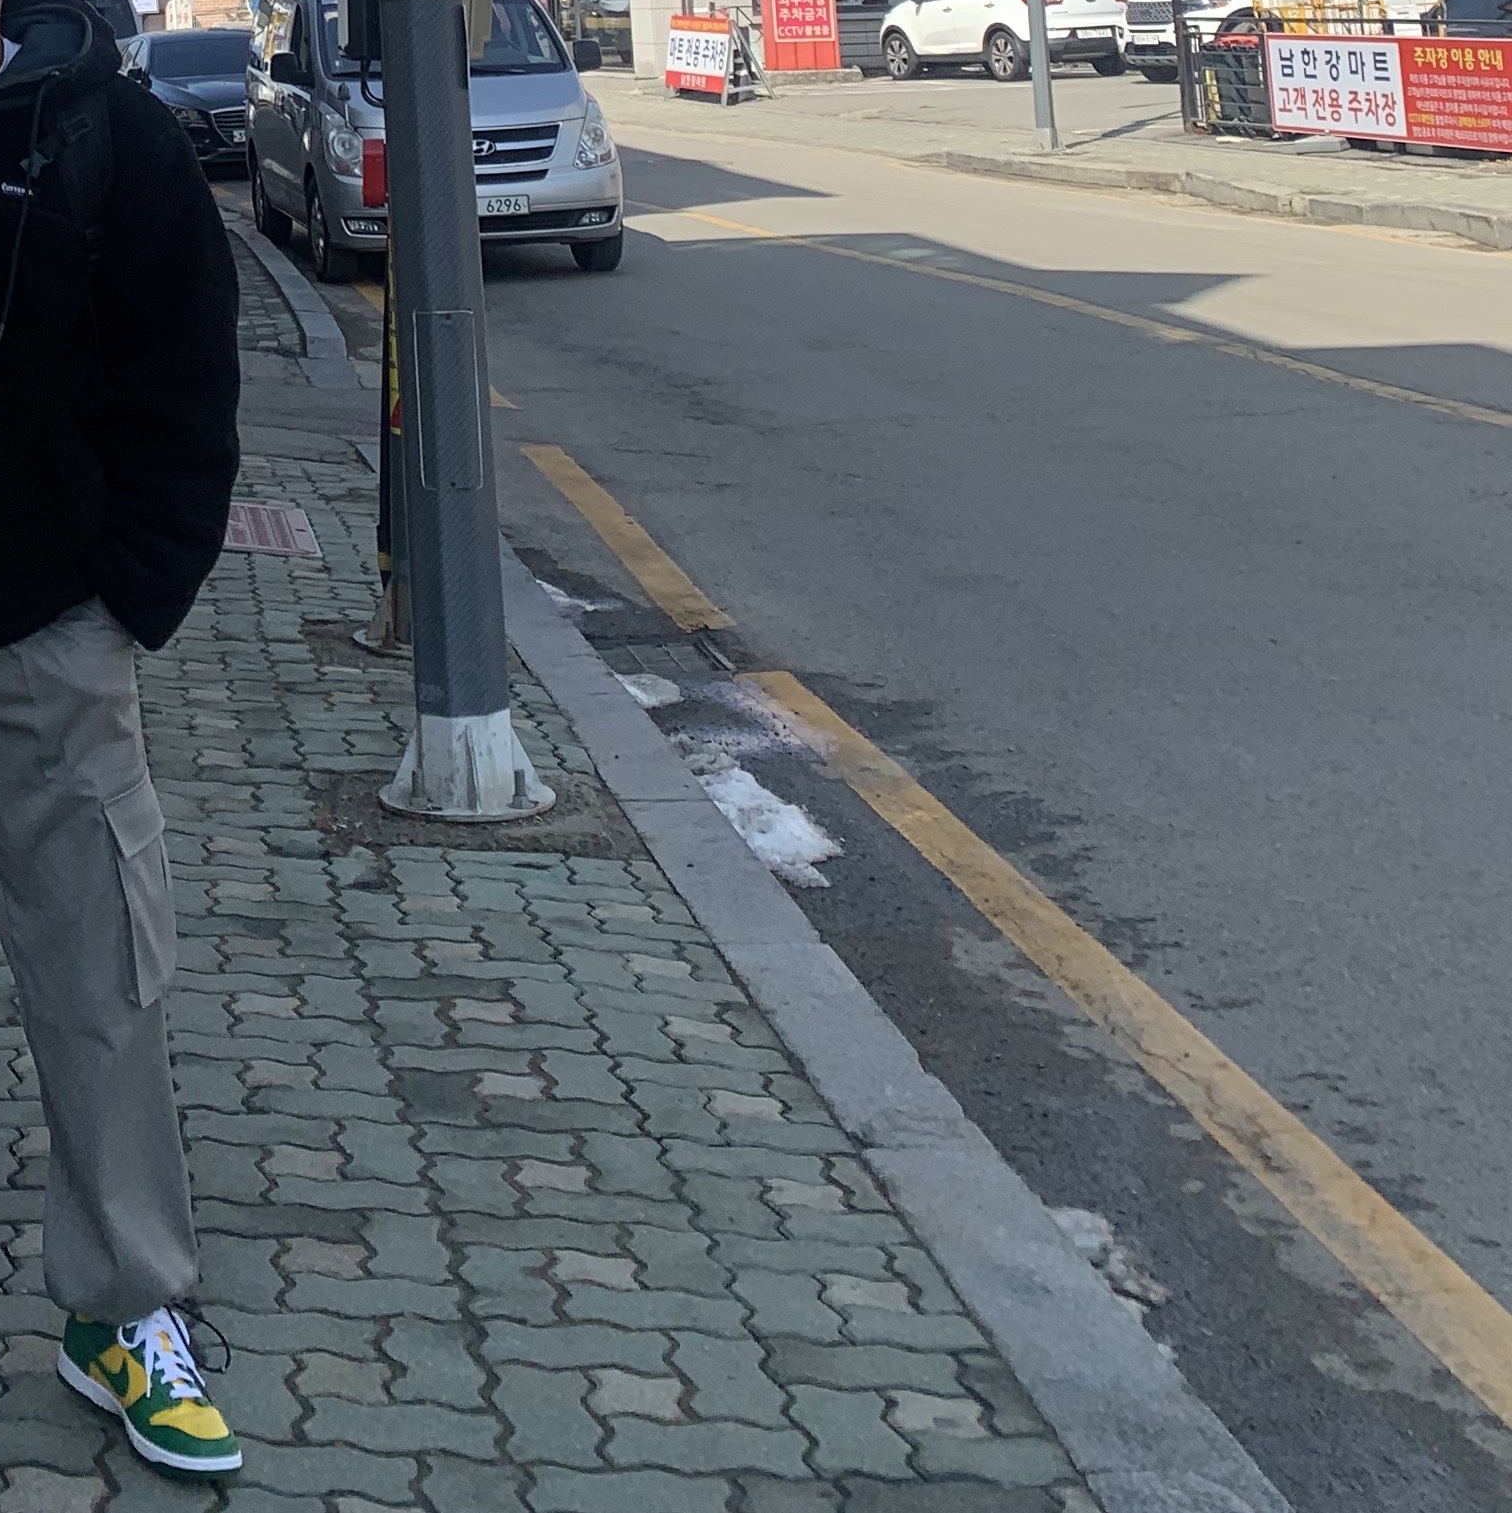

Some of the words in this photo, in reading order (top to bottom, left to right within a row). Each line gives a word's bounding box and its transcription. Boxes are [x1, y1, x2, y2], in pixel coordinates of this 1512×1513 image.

[779, 7, 828, 21] 주차금지
[669, 36, 684, 65] 마트
[686, 37, 700, 68] 전용
[702, 39, 727, 70] 주차장
[1278, 48, 1391, 82] 남한강마트
[1450, 48, 1476, 70] 이용
[1477, 48, 1504, 71] 안내
[1278, 87, 1308, 120] 고객
[1312, 88, 1343, 122] 전용
[1348, 90, 1397, 127] 주차장
[486, 197, 522, 213] 6296
